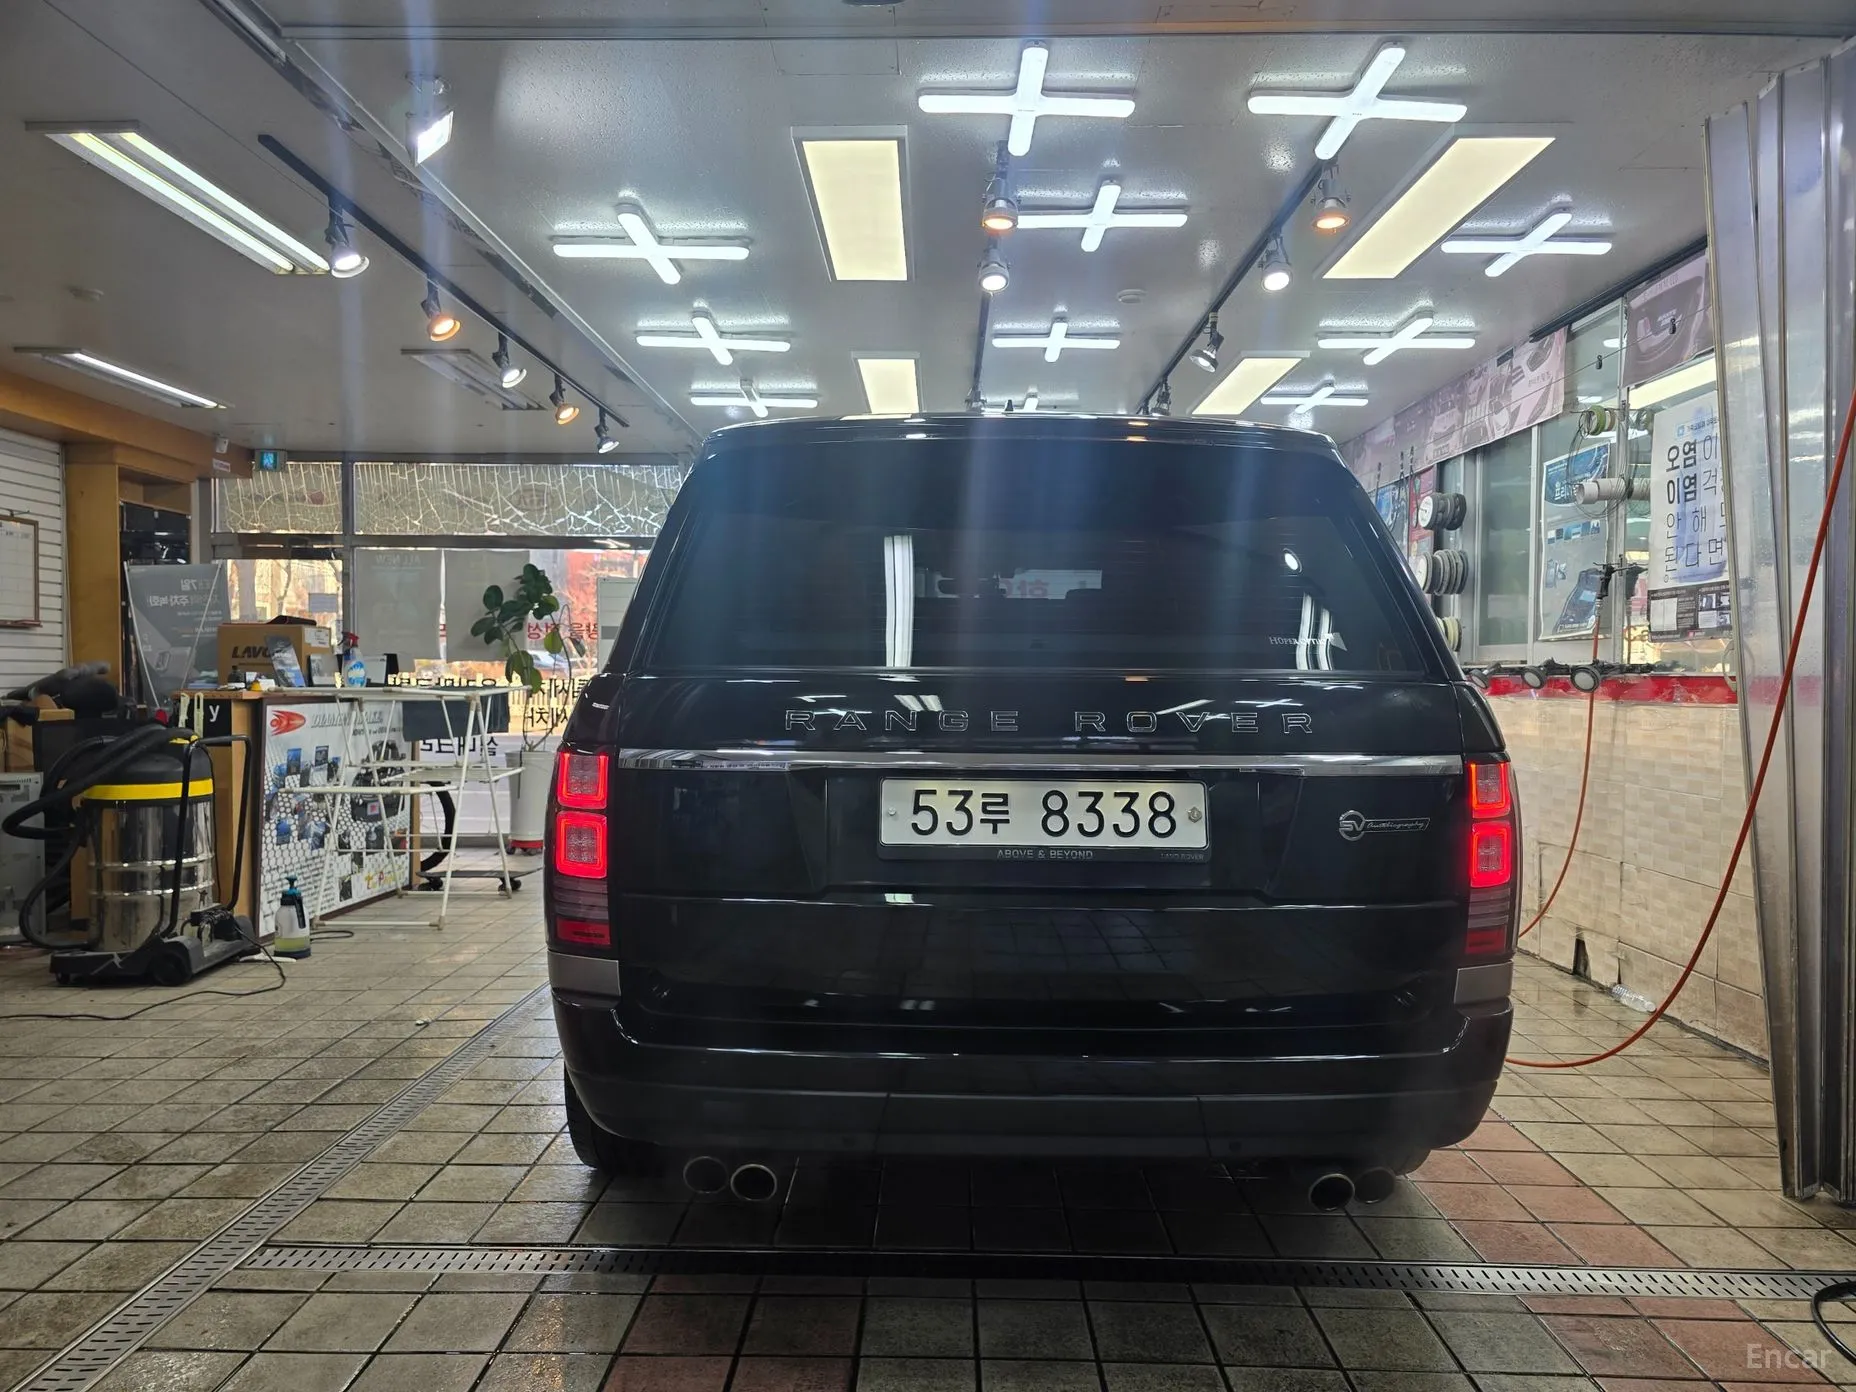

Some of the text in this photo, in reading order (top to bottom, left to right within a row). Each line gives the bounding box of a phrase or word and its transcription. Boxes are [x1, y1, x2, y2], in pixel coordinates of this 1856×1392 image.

[785, 709, 1312, 734] RANGE ROVER
[910, 788, 1177, 838] 53루 8338
[997, 849, 1093, 860] ABOVE & BEYOND
